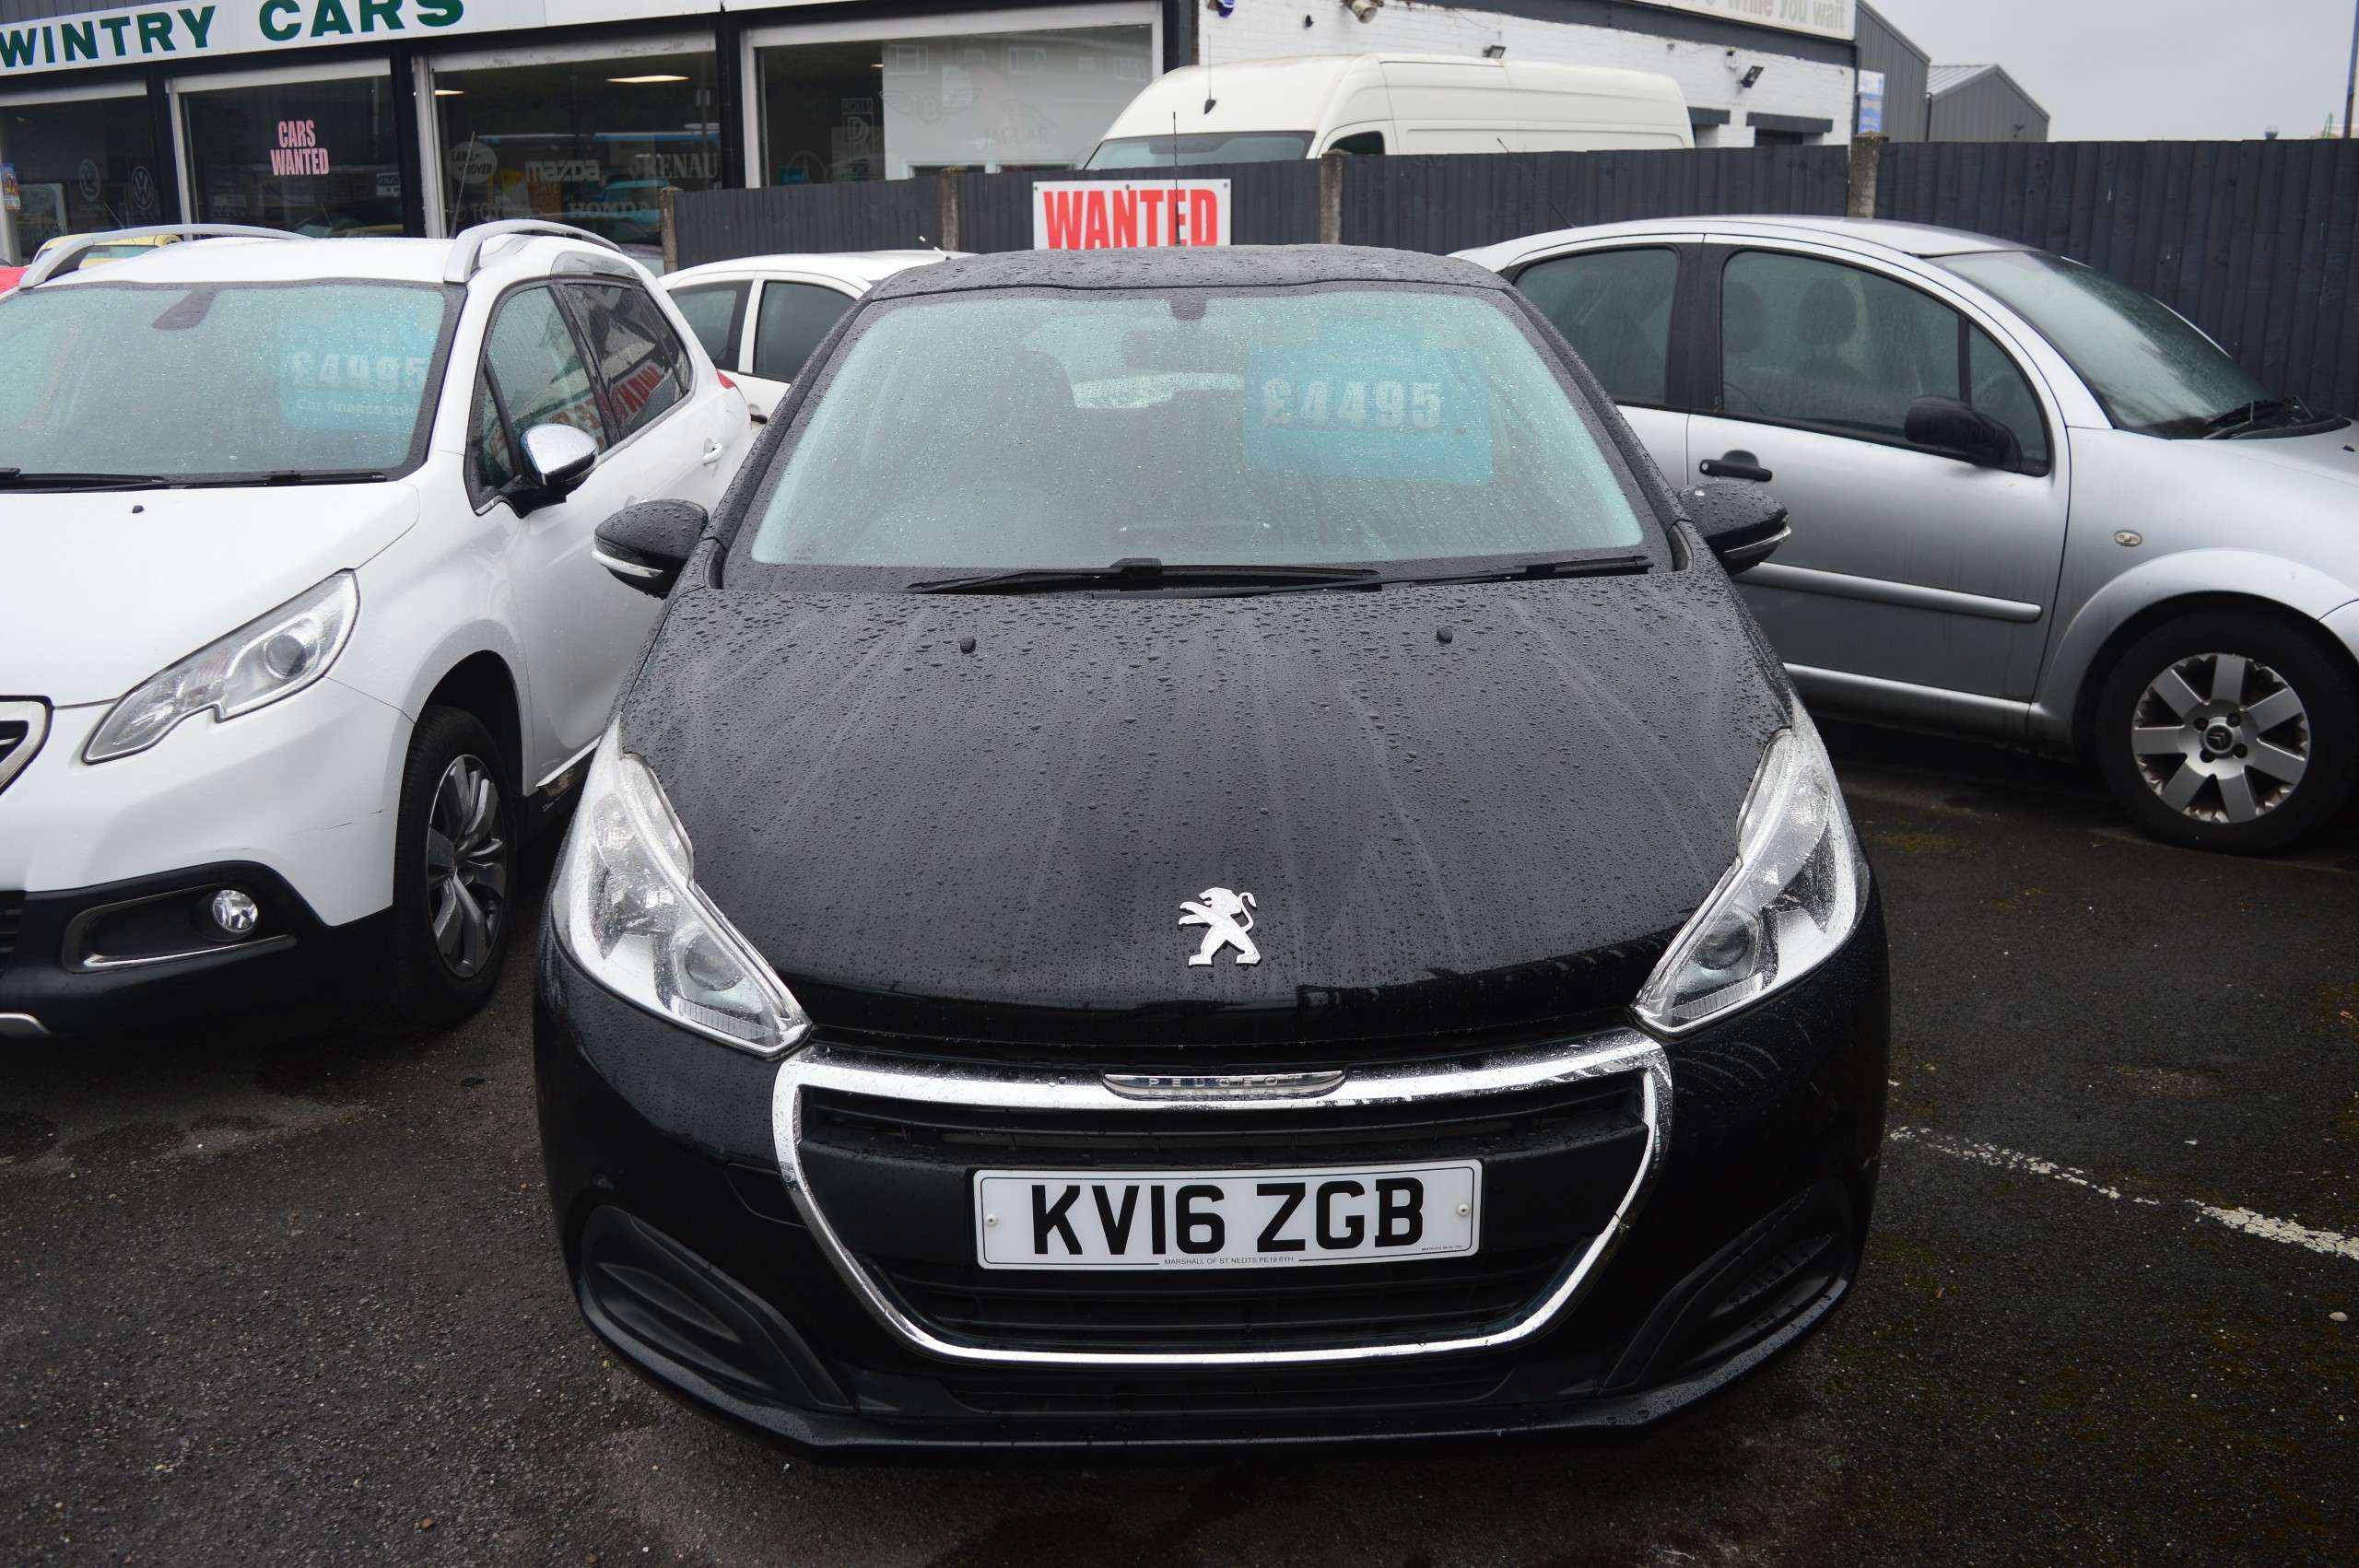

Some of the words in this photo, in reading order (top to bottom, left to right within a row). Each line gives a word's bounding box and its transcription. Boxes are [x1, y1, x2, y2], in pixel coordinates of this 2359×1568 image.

[0, 6, 216, 67] WINTRY
[259, 0, 464, 41] CARS
[270, 147, 330, 176] WANTED
[278, 120, 316, 147] CARS
[1043, 188, 1218, 251] WANTED
[1261, 377, 1443, 429] £4495
[1031, 1184, 1226, 1256] KV16
[1256, 1176, 1425, 1253] ZGB
